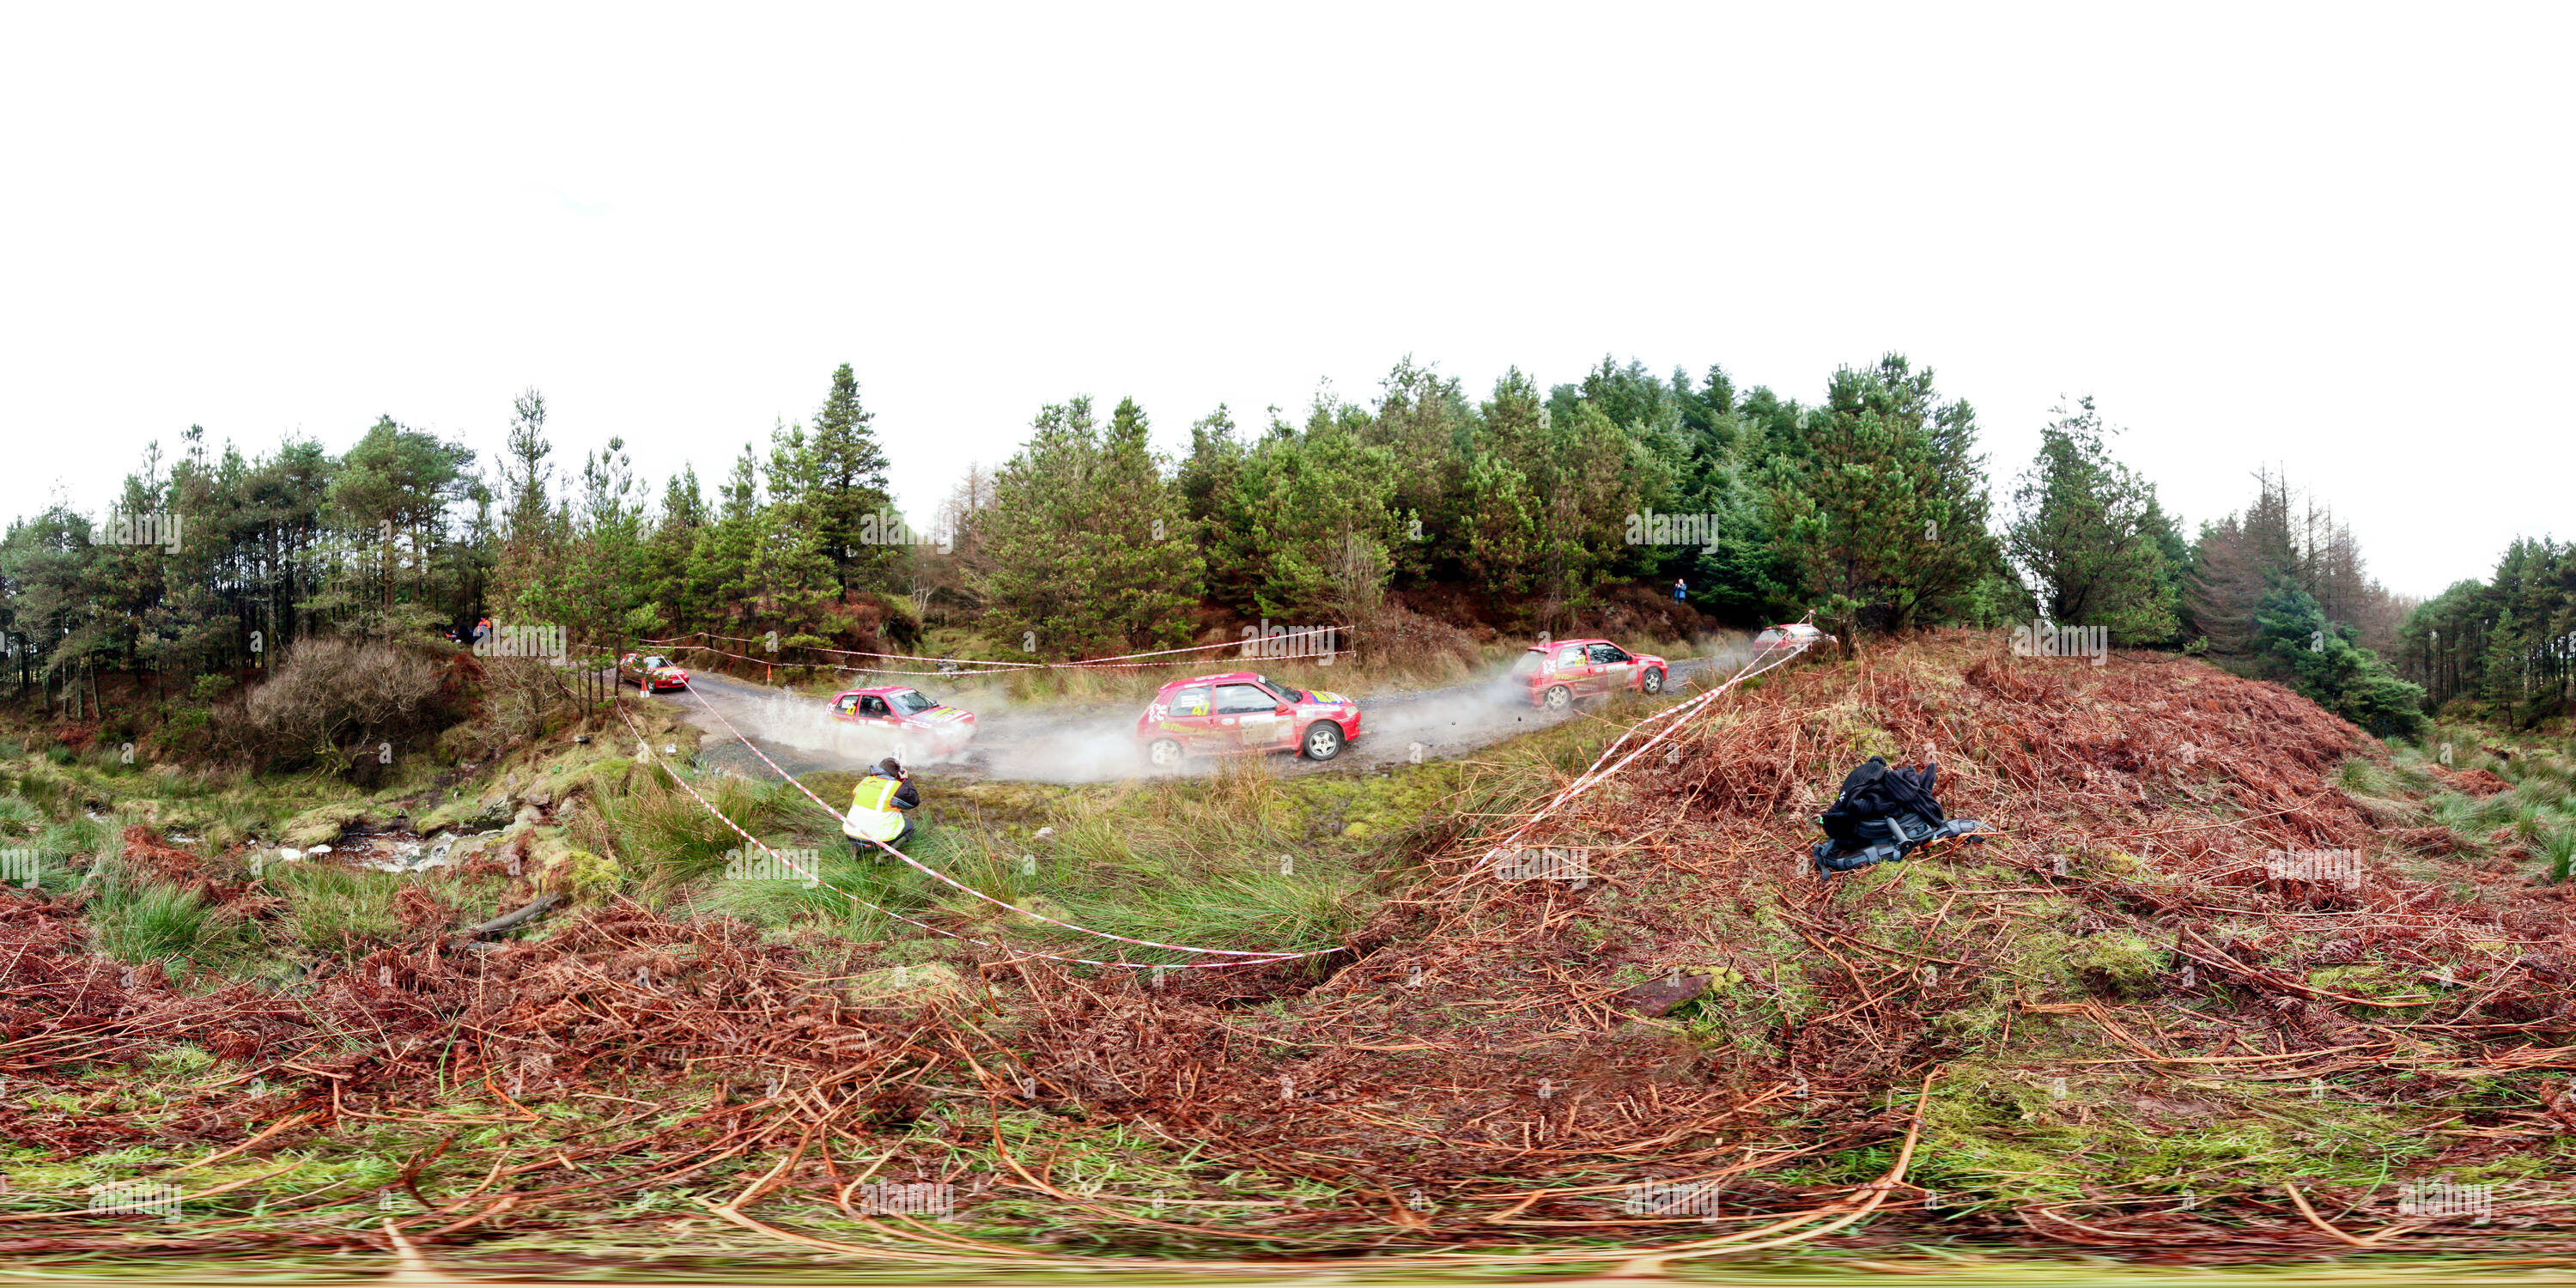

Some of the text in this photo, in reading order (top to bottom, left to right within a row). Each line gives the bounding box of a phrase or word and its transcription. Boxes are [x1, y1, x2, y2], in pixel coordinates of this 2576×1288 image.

[1574, 656, 1586, 666] 47
[845, 705, 856, 715] 47
[1192, 702, 1210, 716] 47
